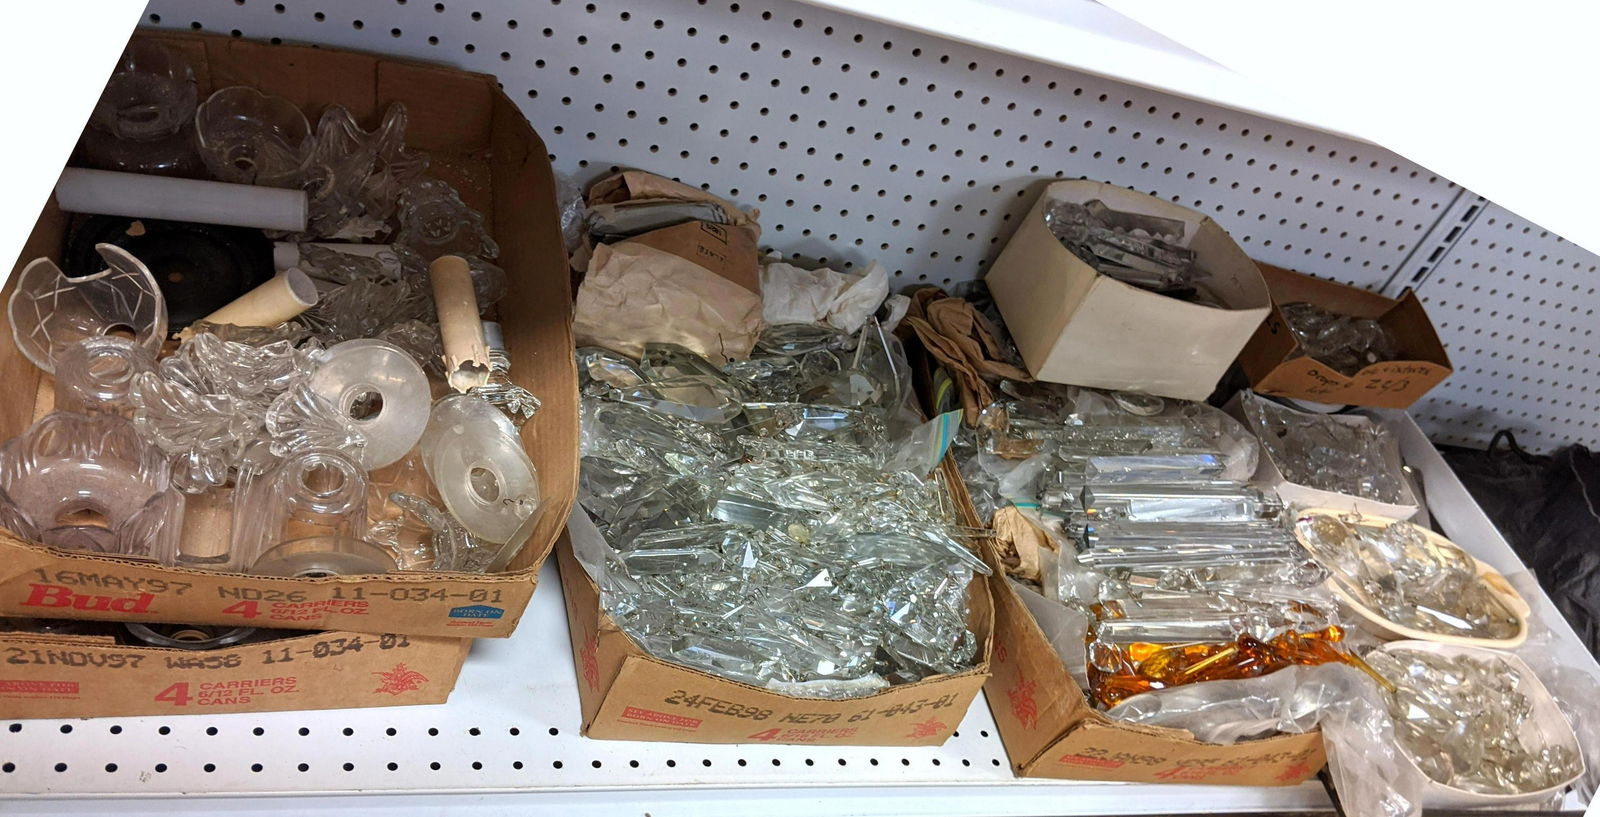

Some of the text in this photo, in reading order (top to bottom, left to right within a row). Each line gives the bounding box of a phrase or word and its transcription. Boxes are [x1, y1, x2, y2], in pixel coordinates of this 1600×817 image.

[34, 568, 193, 596] 16MAY97
[332, 586, 503, 603] 11-034-01
[20, 583, 155, 614] Bud
[271, 599, 369, 609] CARRIERS
[222, 600, 262, 620] 4
[269, 614, 323, 622] CANS
[5, 646, 147, 669] 21NOV97
[262, 633, 411, 665] 11-034-01
[198, 685, 300, 698] 6/12 FL. OZ.
[199, 676, 297, 690] CARRIERS
[154, 681, 193, 707] 4
[197, 696, 251, 706] CANS
[664, 689, 774, 721] 24FEB98
[747, 727, 782, 742] 4
